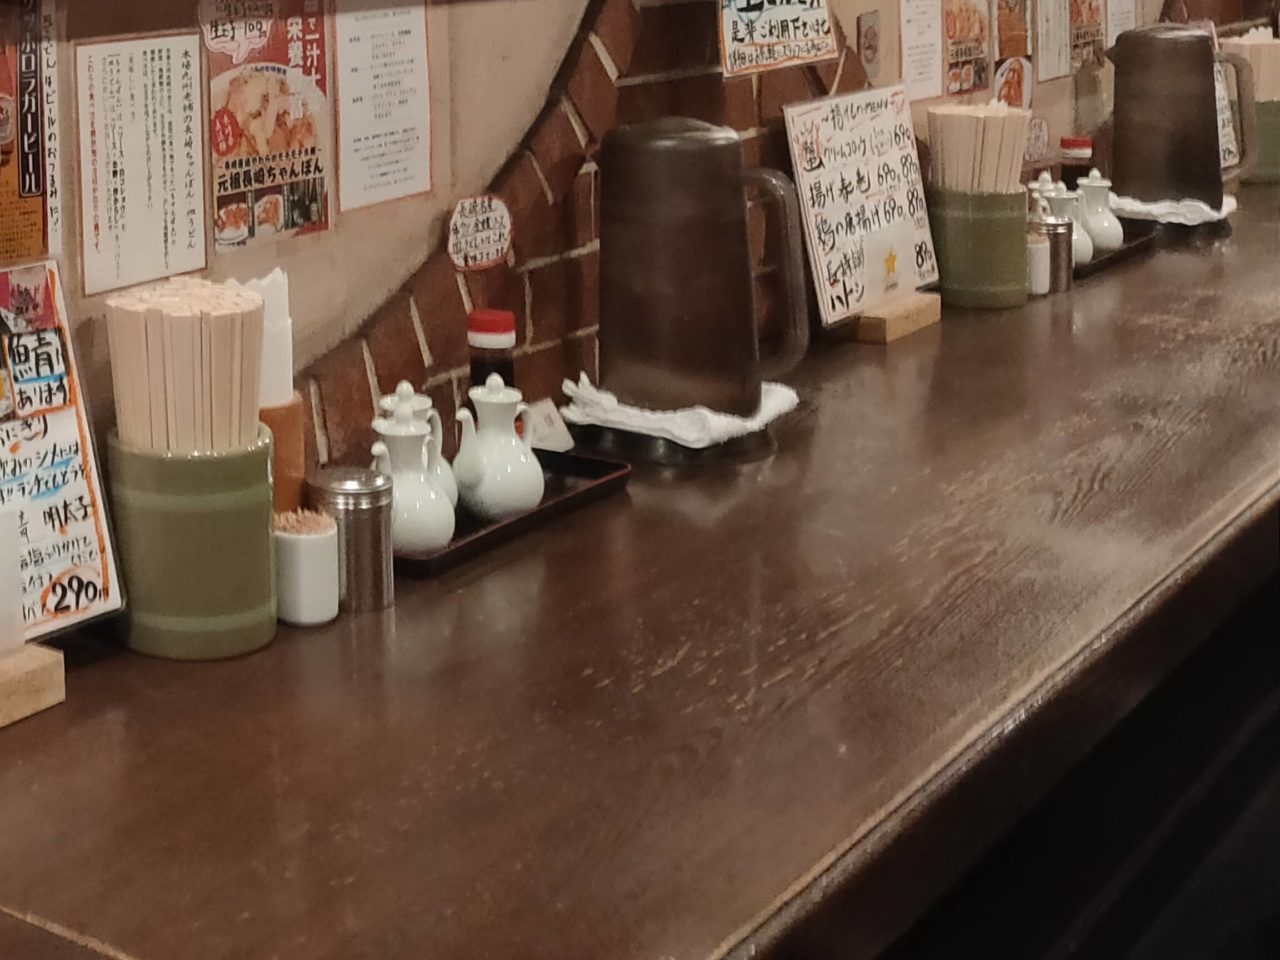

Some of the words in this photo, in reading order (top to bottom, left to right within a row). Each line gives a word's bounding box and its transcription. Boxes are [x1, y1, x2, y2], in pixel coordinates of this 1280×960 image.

[217, 158, 324, 193] 元祖長崎ちゃんぽん
